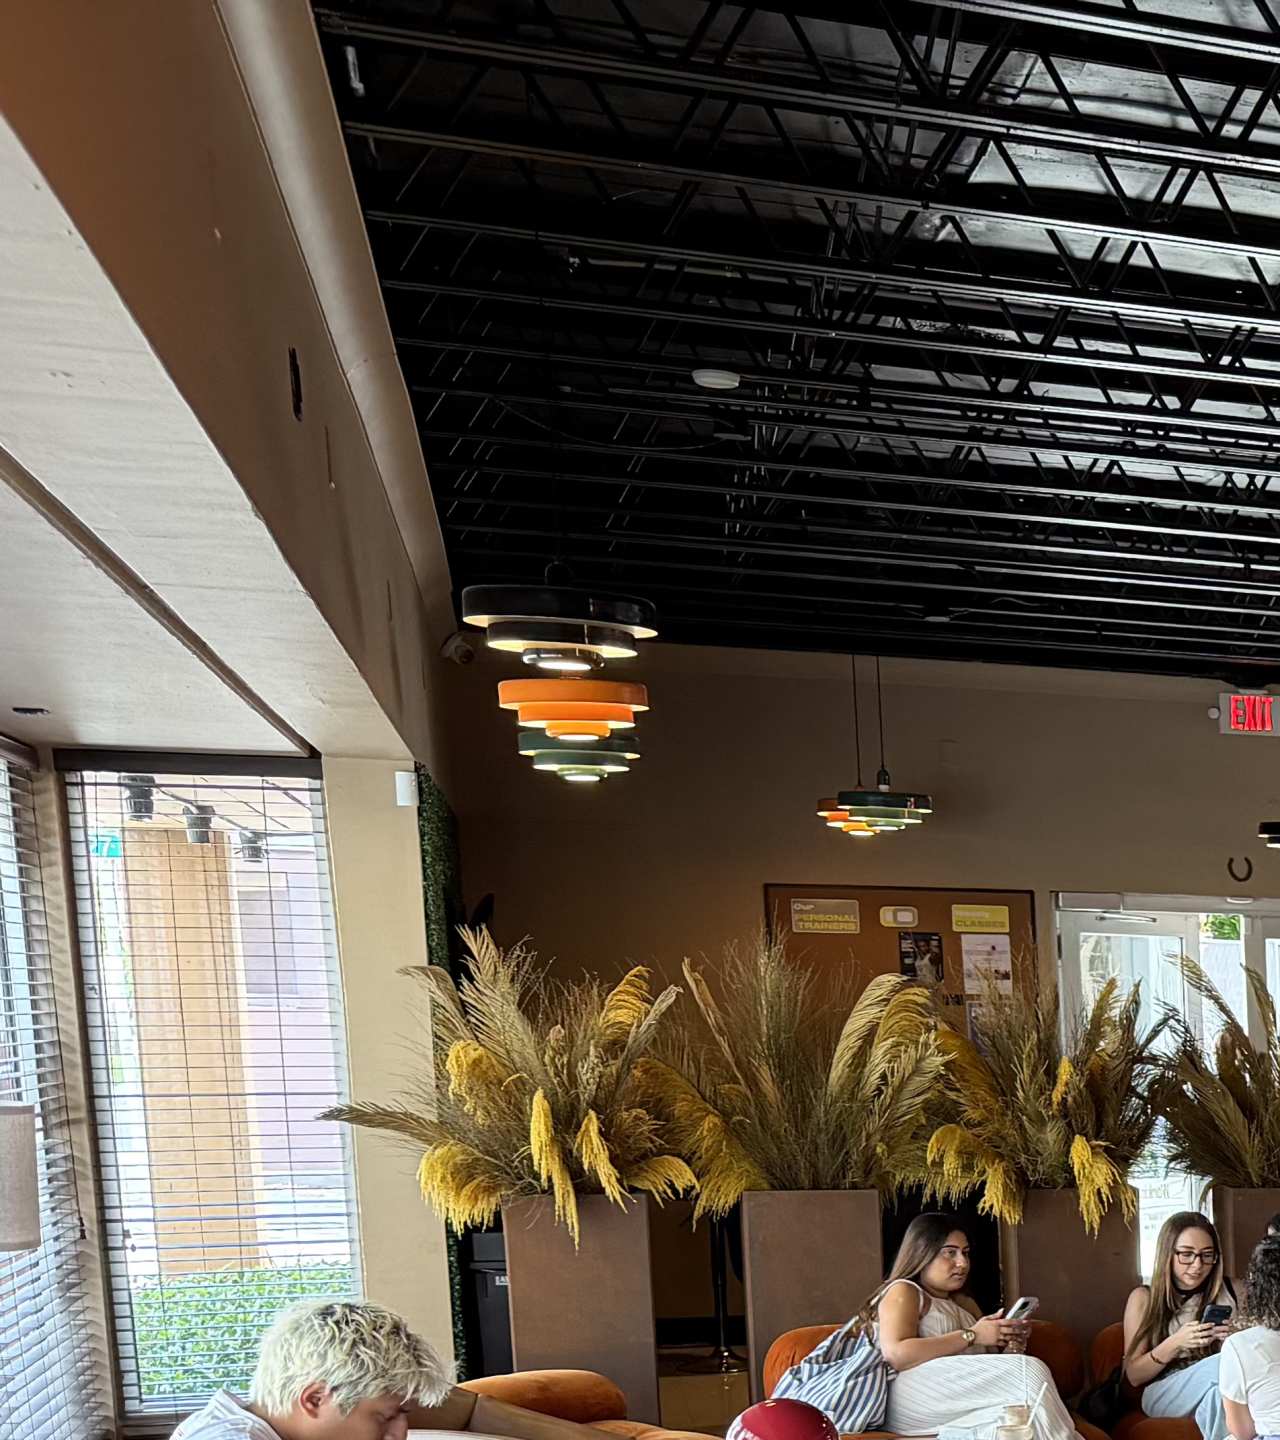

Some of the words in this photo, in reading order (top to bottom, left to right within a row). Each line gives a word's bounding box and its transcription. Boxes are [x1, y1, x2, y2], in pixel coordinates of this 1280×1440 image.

[1230, 695, 1274, 732] EXIT
[793, 902, 816, 911] Our
[795, 912, 857, 922] PERSONAL
[797, 921, 856, 930] TRAINERS
